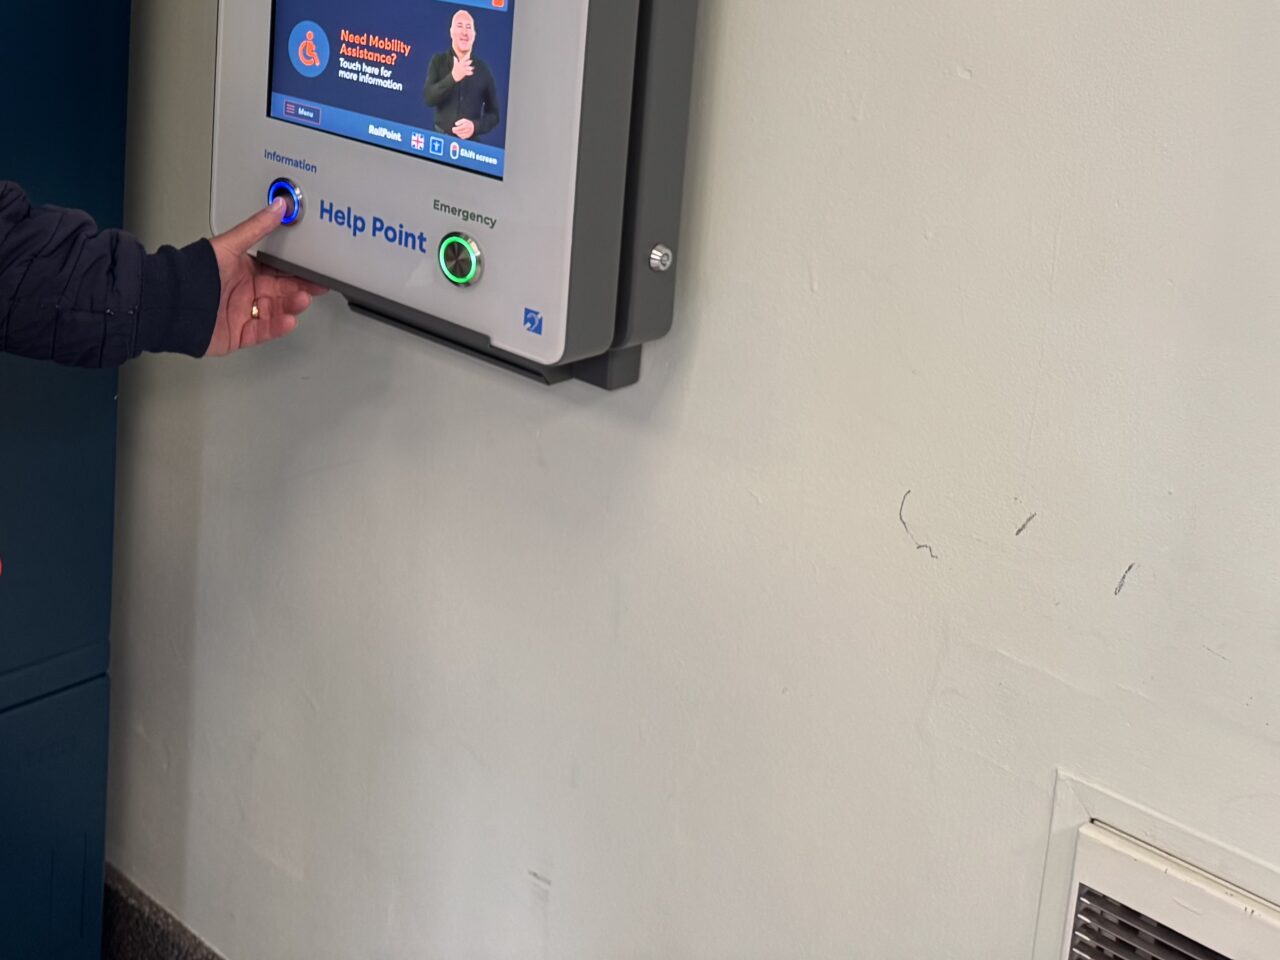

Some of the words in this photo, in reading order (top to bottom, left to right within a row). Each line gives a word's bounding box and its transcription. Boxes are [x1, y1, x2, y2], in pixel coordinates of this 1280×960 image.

[339, 43, 397, 66] Assistance?
[340, 29, 367, 46] Need
[369, 34, 411, 57] Mobility
[339, 58, 361, 72] Touch
[362, 62, 380, 76] here
[380, 66, 392, 78] for
[338, 69, 358, 82] more
[358, 71, 403, 92] information
[298, 107, 314, 119] Menu
[264, 148, 317, 174] Information
[460, 148, 475, 161] Shift
[475, 153, 498, 165] screen
[432, 199, 497, 229] Emergency
[319, 199, 366, 237] Help
[372, 216, 427, 254] Point
